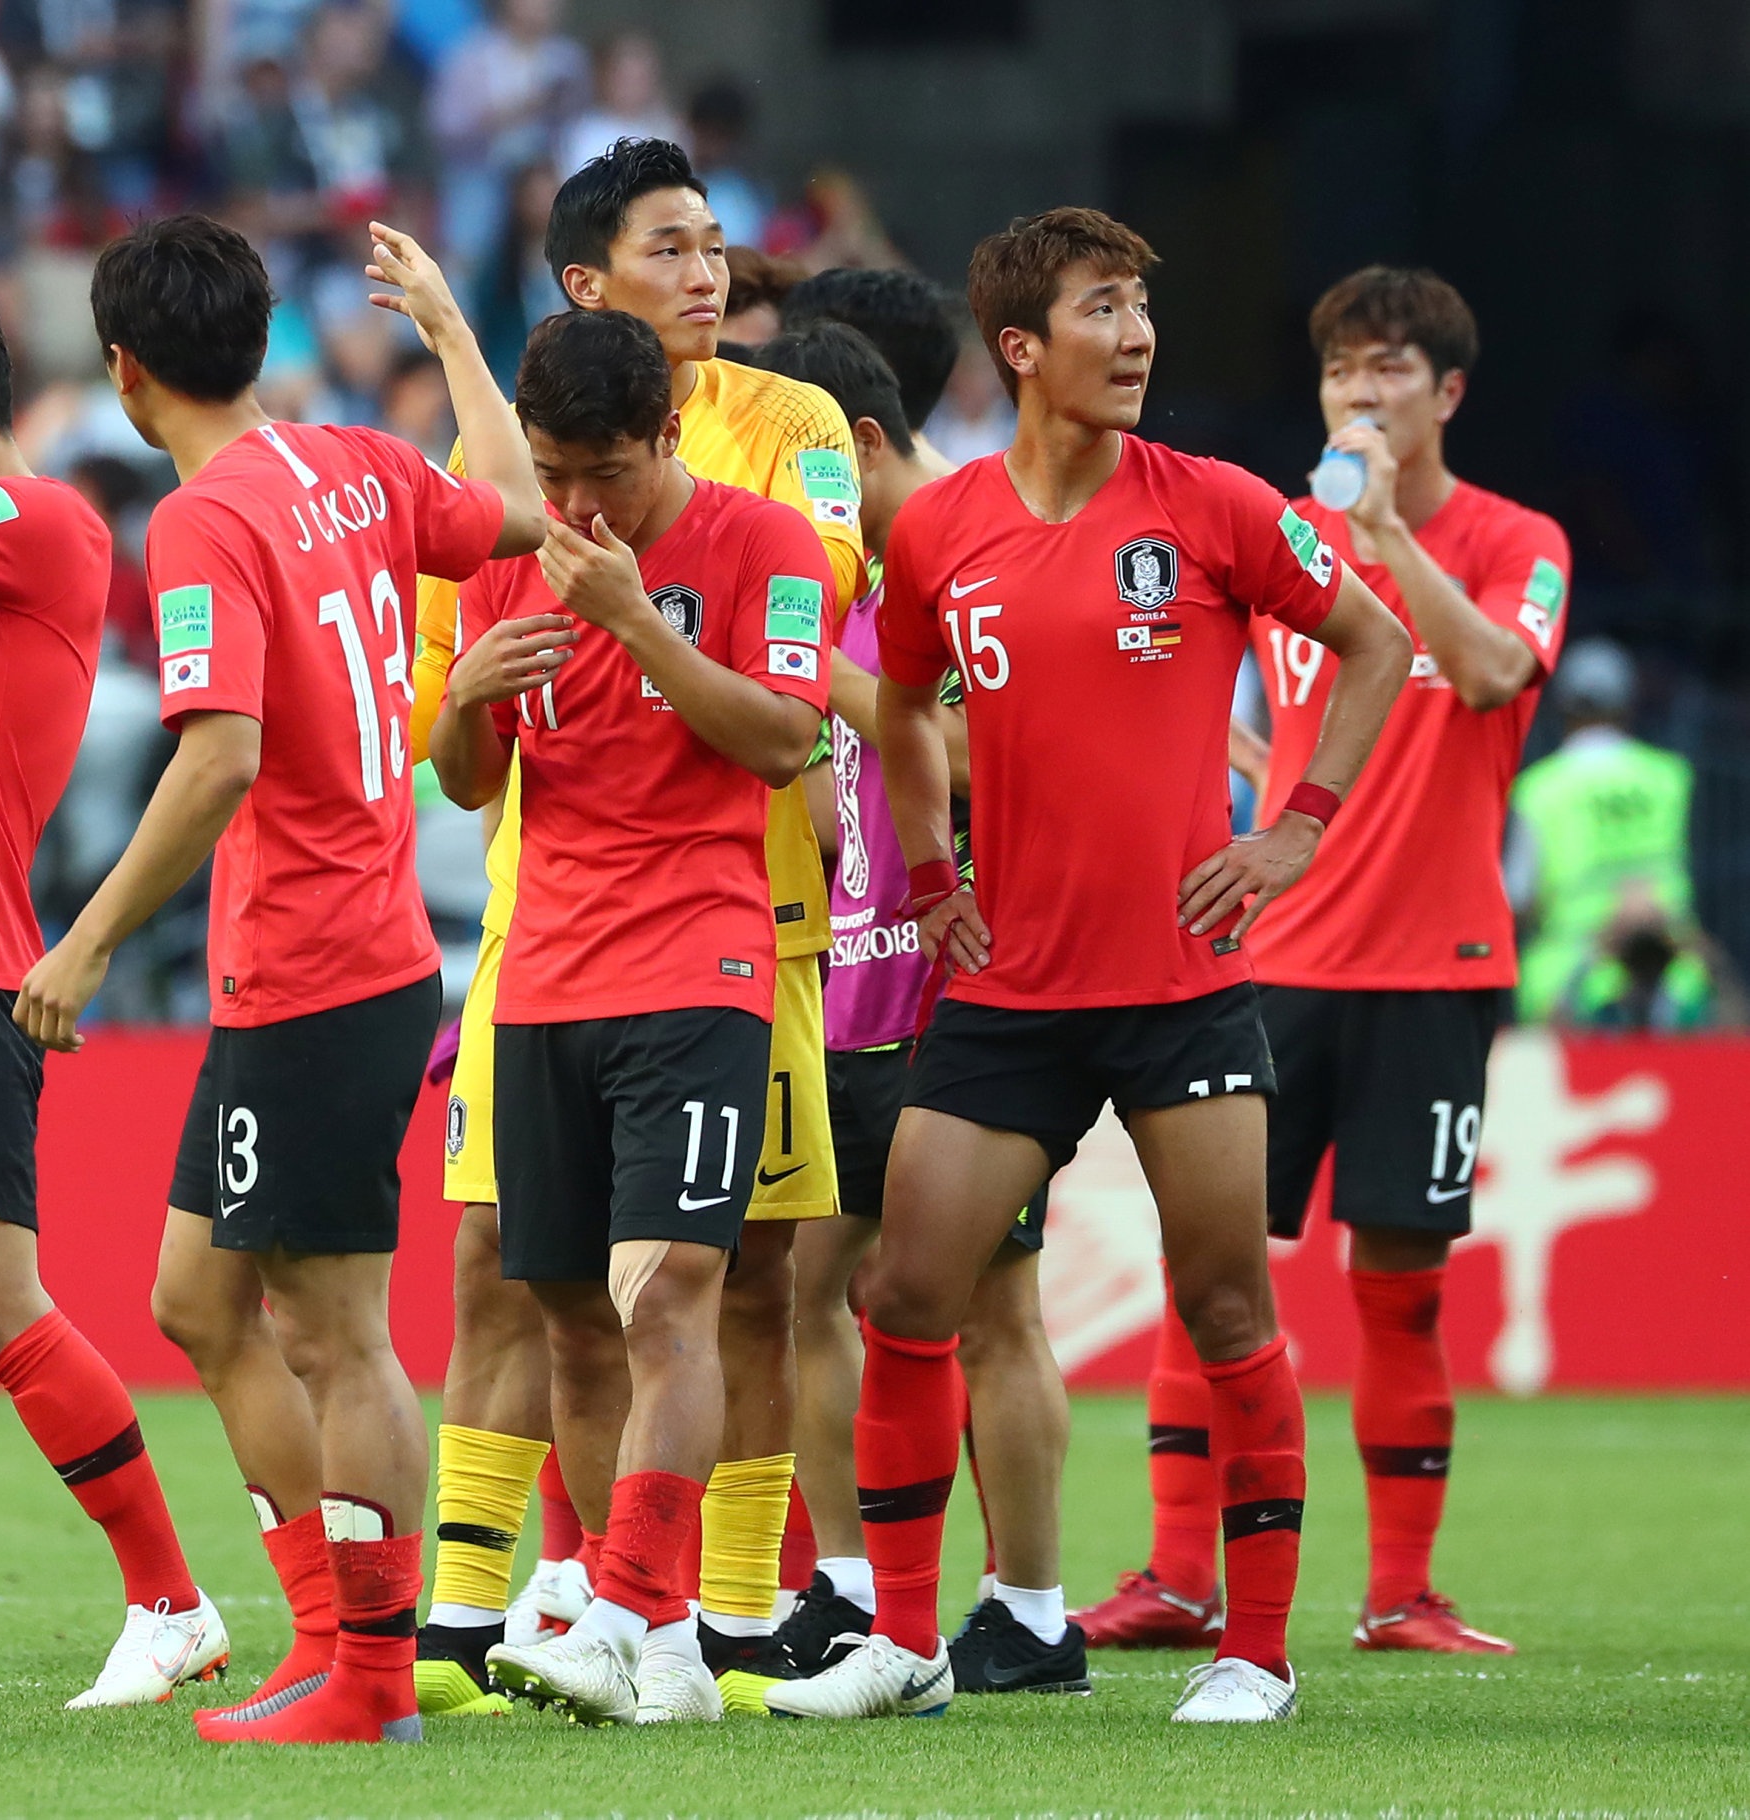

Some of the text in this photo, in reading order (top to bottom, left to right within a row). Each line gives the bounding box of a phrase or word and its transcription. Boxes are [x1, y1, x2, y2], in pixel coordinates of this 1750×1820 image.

[163, 604, 207, 619] LIVING
[771, 602, 817, 615] FOOTBALL
[772, 595, 817, 607] LIVING
[1130, 611, 1168, 622] KOREA
[318, 569, 416, 802] 13
[944, 604, 1010, 692] 15
[1139, 654, 1157, 662] JUNE
[1157, 652, 1173, 660] 2018
[1267, 628, 1326, 707] 19
[681, 1100, 740, 1191] 11
[772, 1071, 792, 1155] 1
[1430, 1099, 1481, 1184] 19
